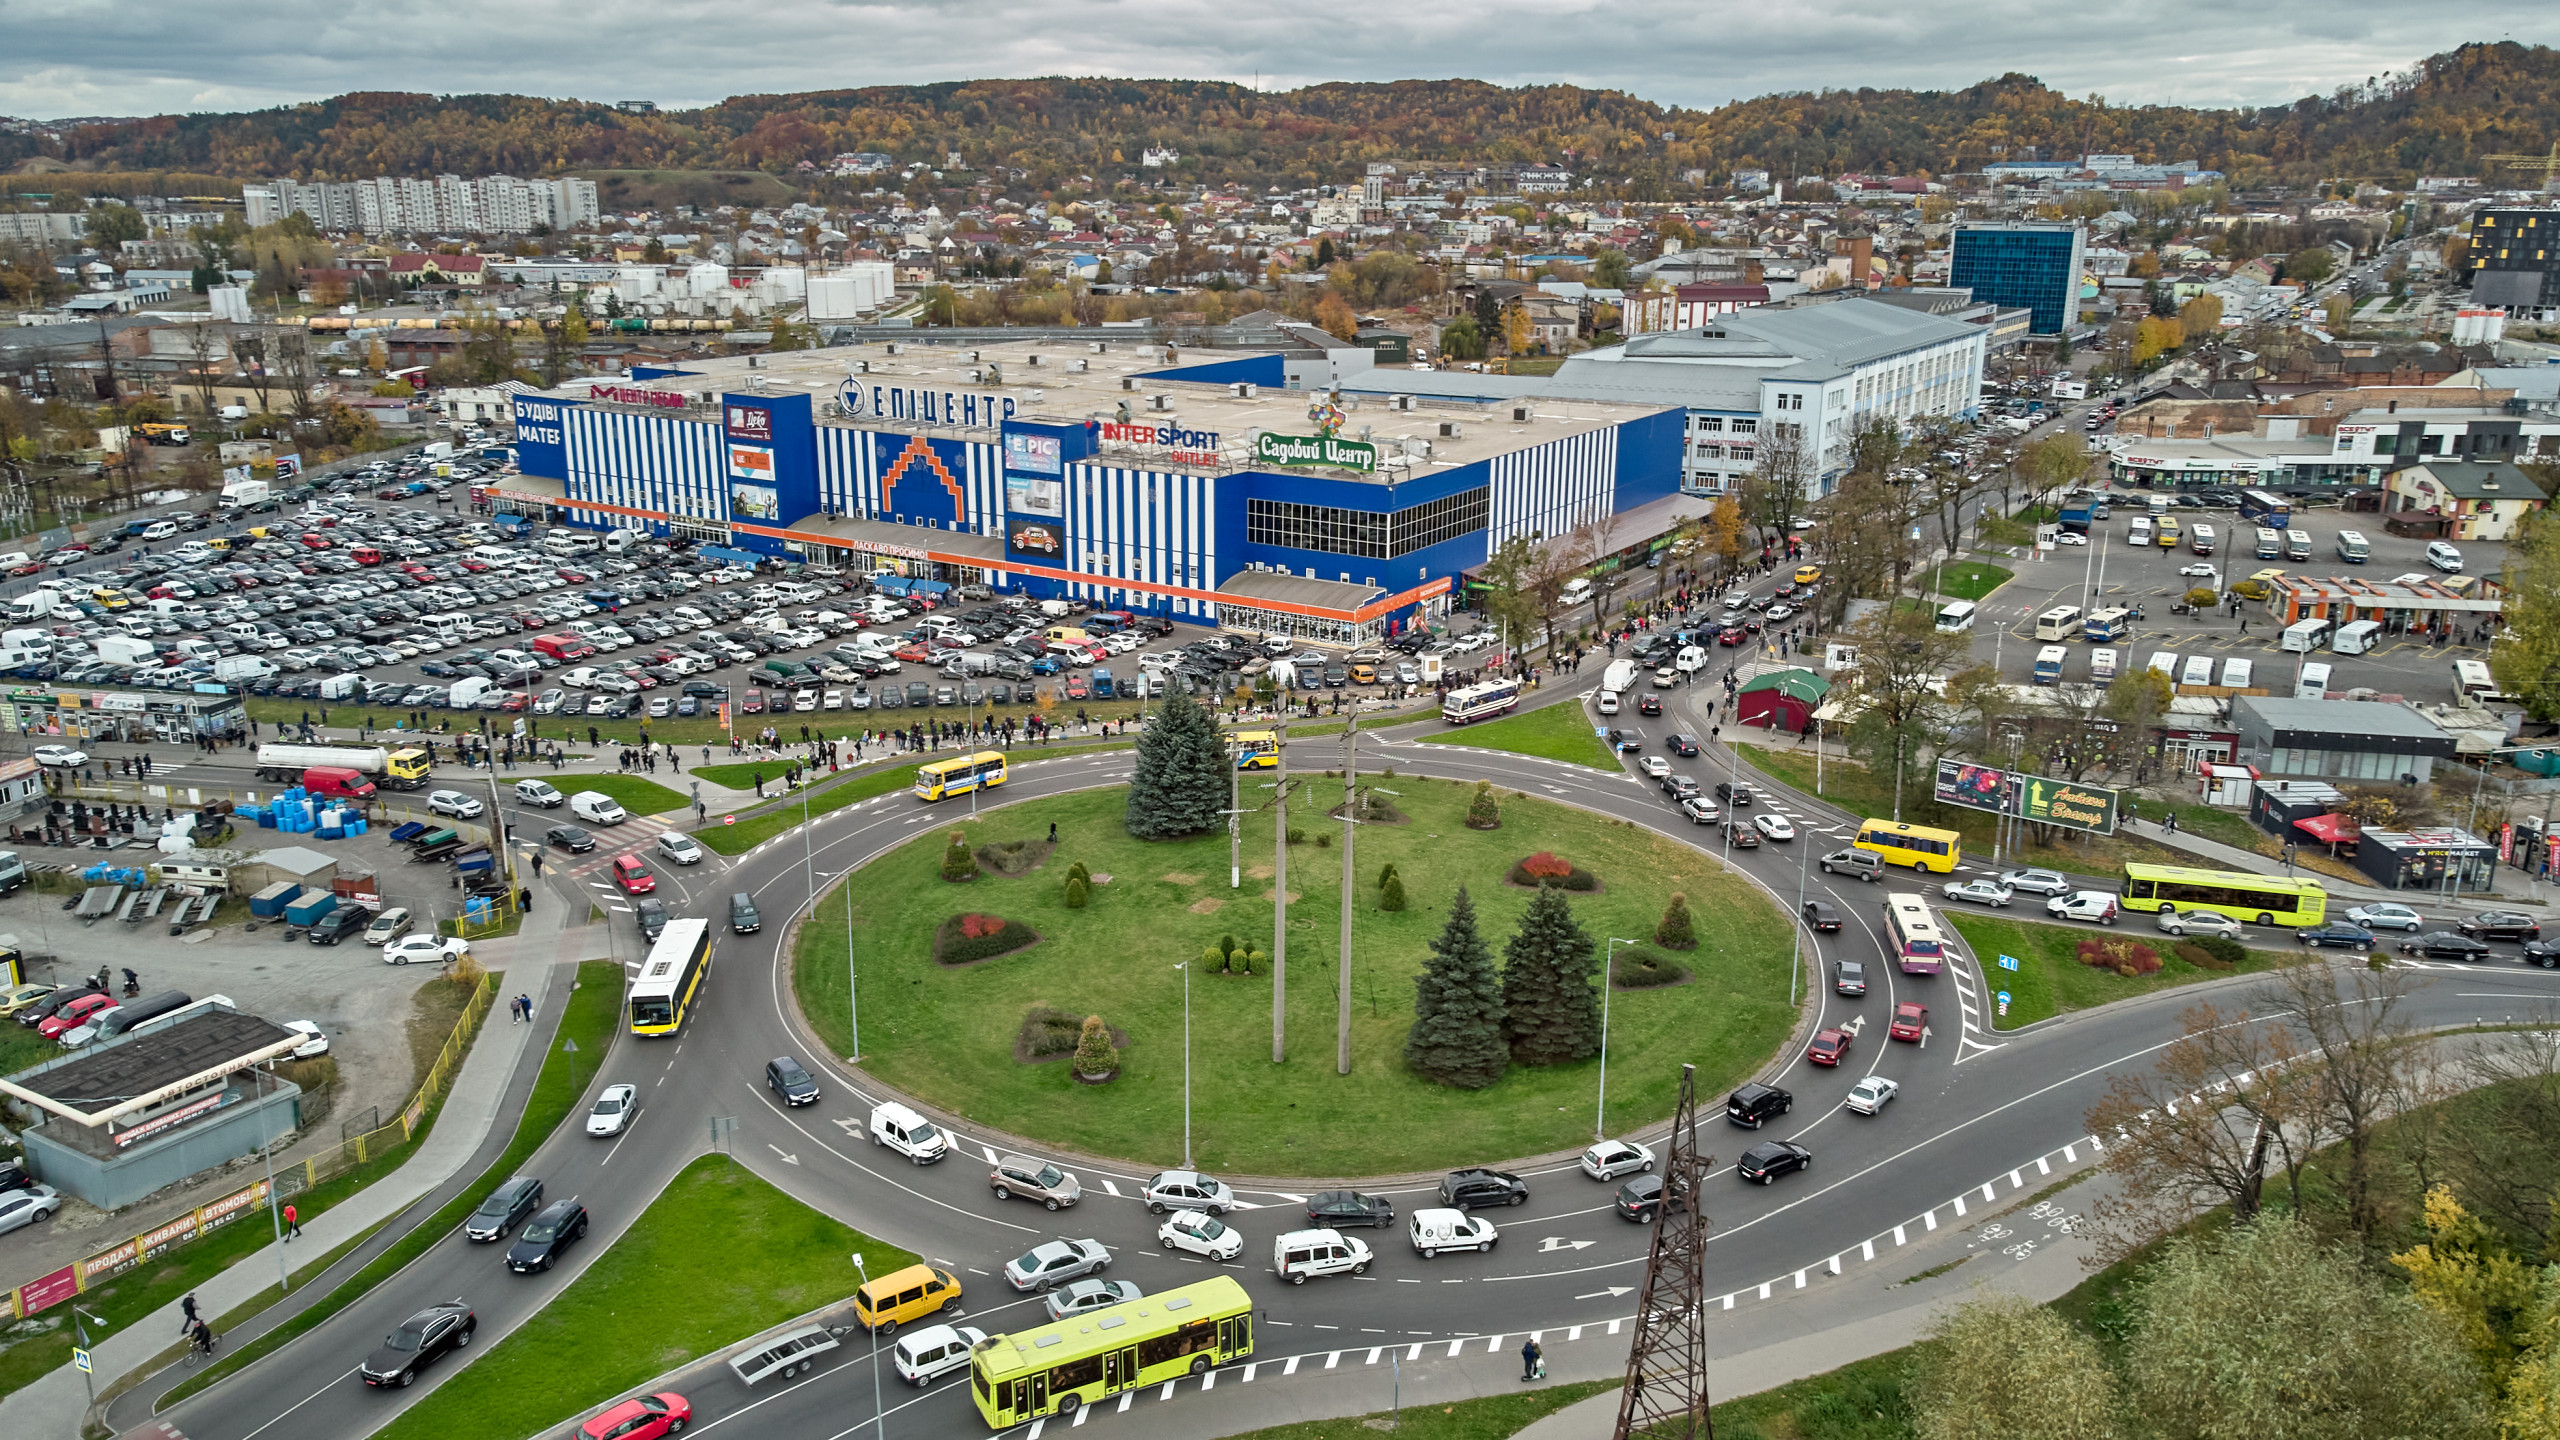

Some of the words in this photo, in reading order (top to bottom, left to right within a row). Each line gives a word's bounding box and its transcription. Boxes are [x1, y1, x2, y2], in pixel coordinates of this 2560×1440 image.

[619, 388, 650, 405] ЦЕНТР
[873, 386, 1018, 428] ЕПІЦЕНТР
[1103, 422, 1220, 450] INTERSPORT
[1171, 450, 1219, 467] OUTLET
[1261, 435, 1320, 464] Садовий
[1325, 440, 1372, 470] Центр
[853, 541, 888, 554] ЛАСКАВО
[889, 545, 928, 560] ПРОСИМО!
[2052, 785, 2107, 809] Аптека
[158, 1058, 253, 1100] АВТОСТОЯНКА
[113, 1262, 129, 1274] 097
[158, 1243, 168, 1254] 79
[214, 1216, 226, 1227] 85
[225, 1211, 236, 1222] 47
[87, 1243, 135, 1274] ПРОДАЖ
